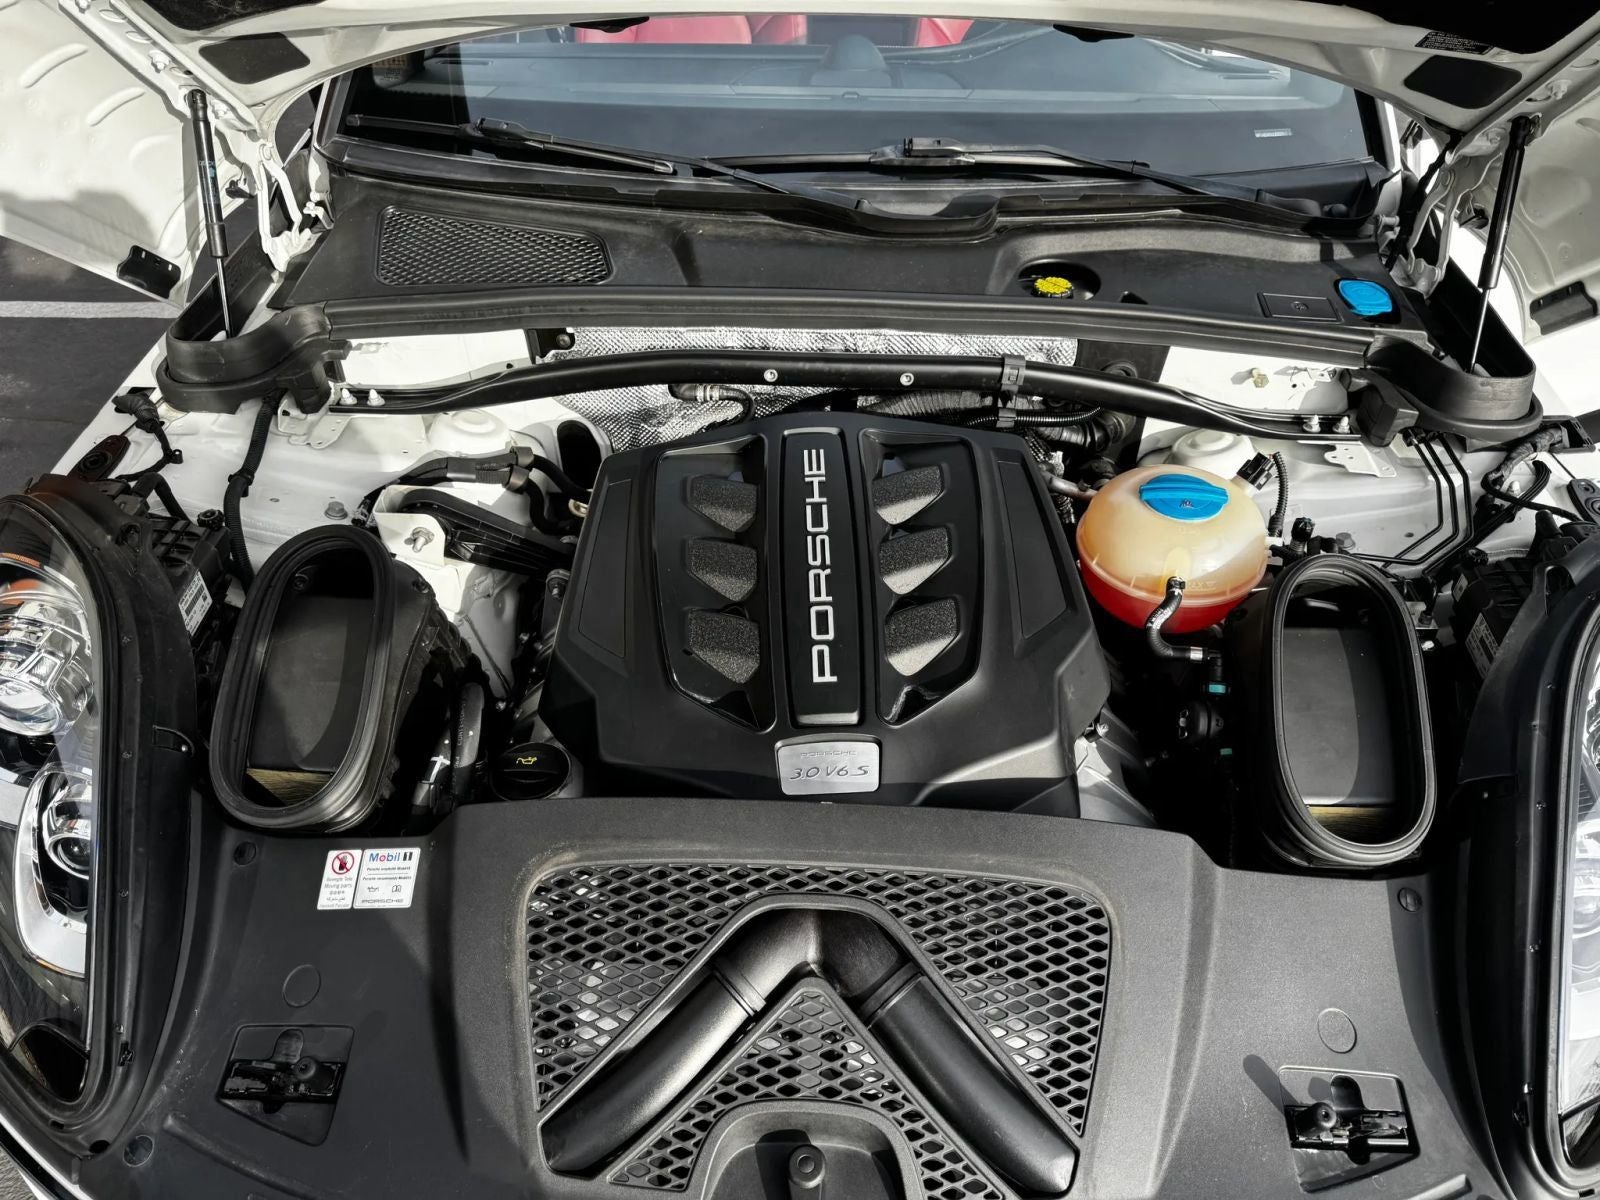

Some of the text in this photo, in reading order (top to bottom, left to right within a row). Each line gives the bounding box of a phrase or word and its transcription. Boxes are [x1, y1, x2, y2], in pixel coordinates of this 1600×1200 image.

[803, 449, 838, 683] PORSCHE
[800, 750, 857, 758] PORSCHE
[369, 852, 401, 862] Mobil
